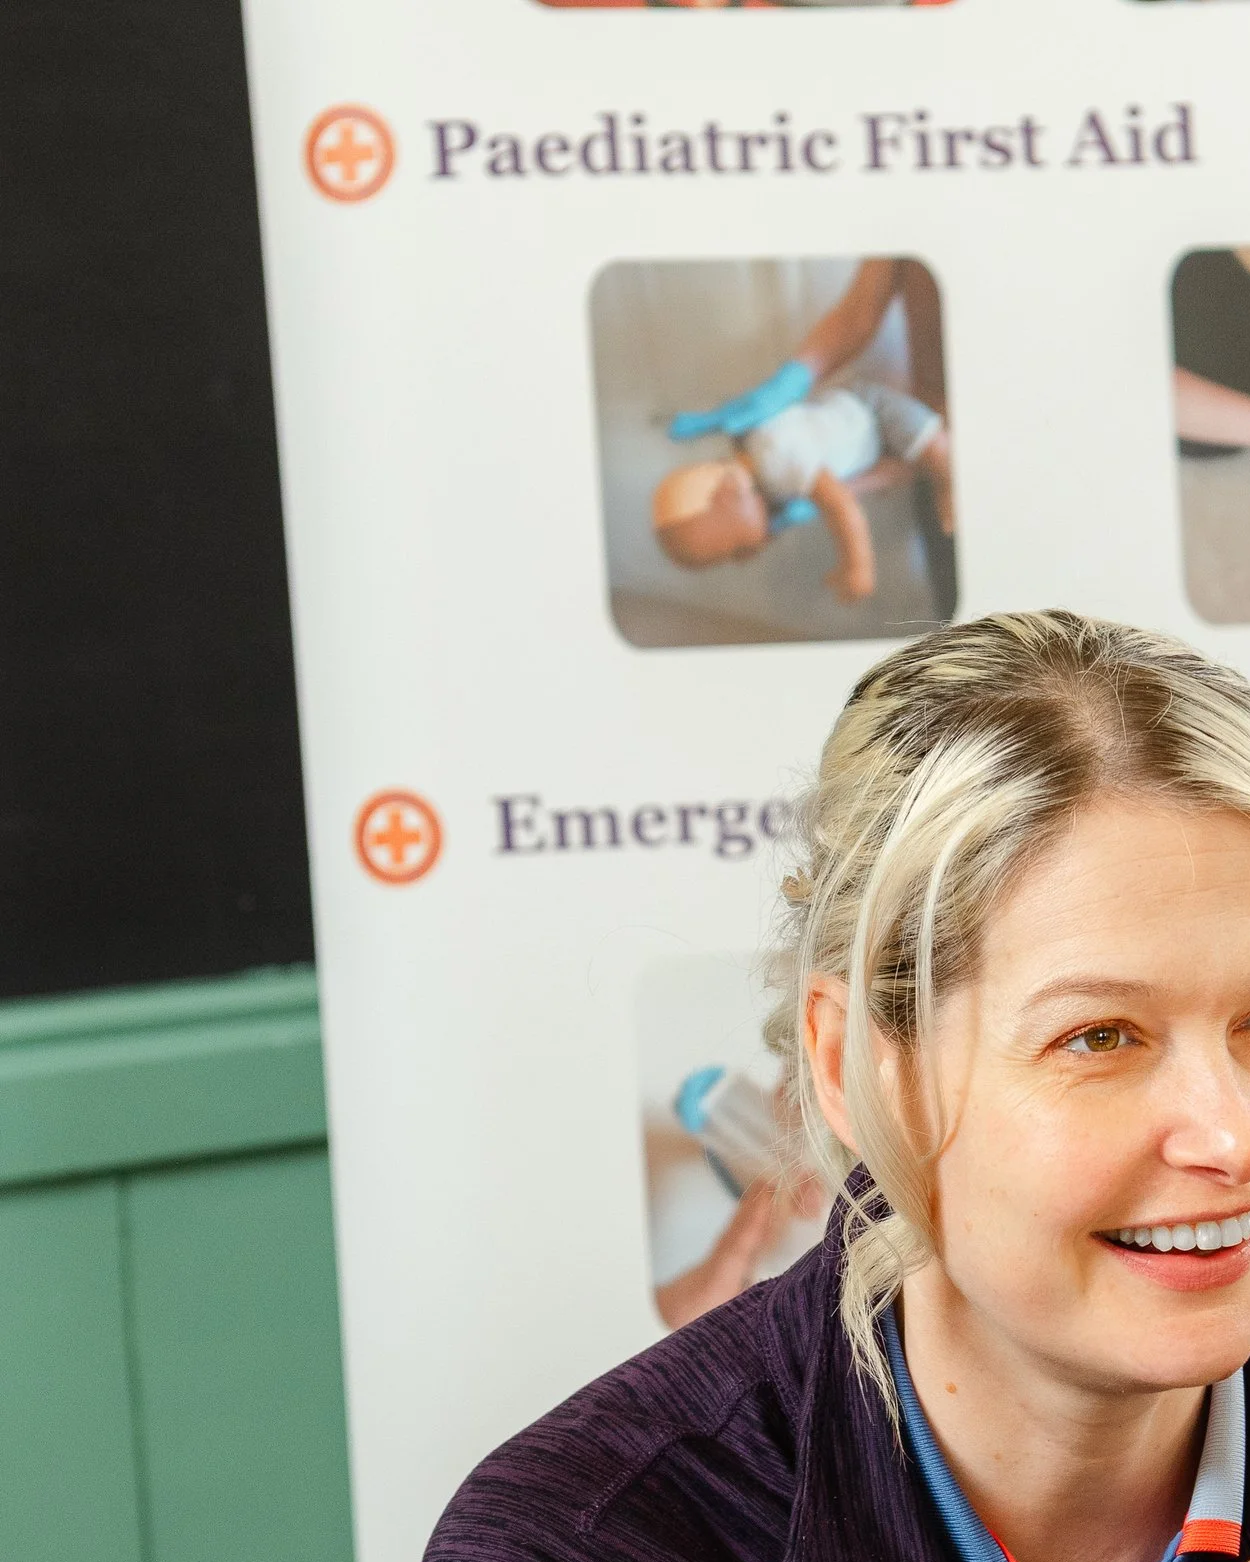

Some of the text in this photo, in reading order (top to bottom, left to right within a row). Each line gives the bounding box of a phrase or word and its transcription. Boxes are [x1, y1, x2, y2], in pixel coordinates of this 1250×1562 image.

[428, 102, 1198, 181] Paediatric First Aid
